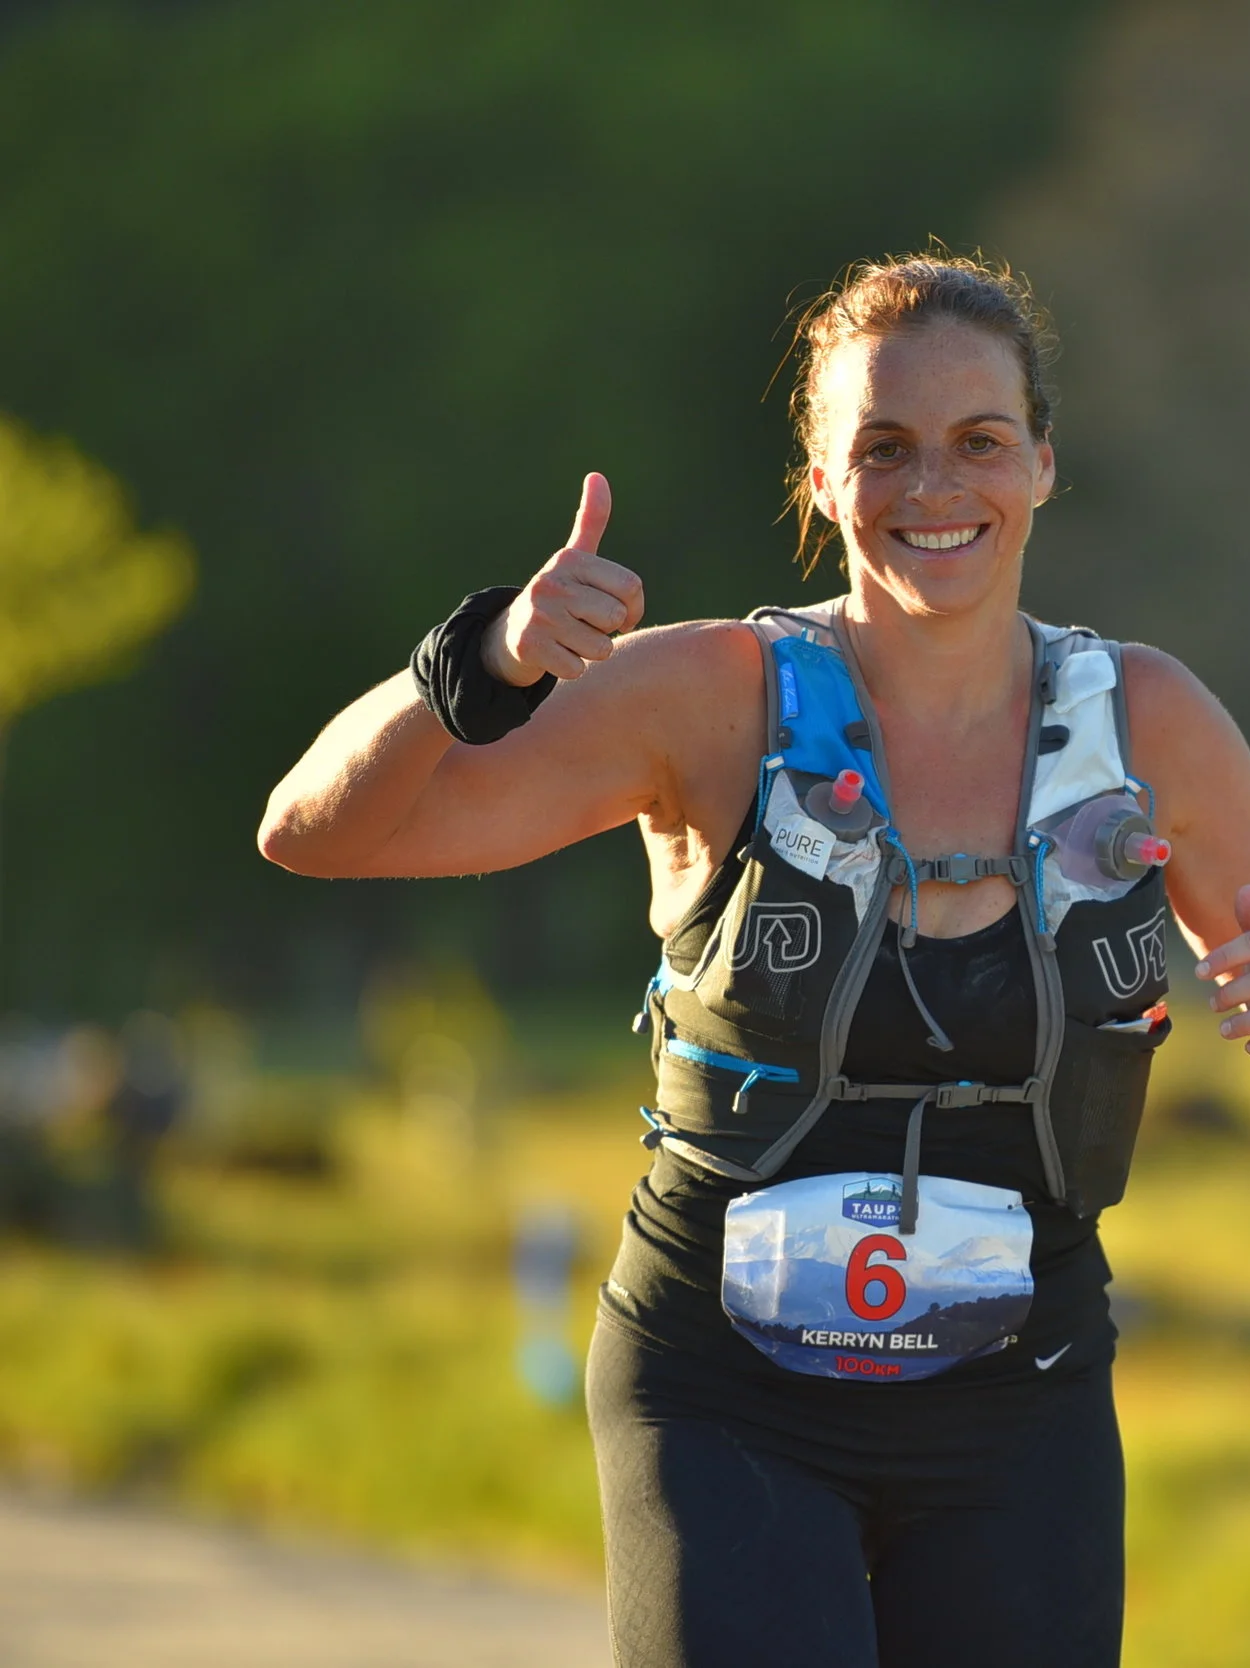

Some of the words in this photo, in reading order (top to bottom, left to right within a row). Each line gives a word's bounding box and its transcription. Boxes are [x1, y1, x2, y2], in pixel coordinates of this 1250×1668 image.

[775, 828, 825, 858] PURE
[852, 1202, 902, 1215] TAUP
[845, 1233, 907, 1321] 6
[801, 1329, 884, 1349] KERRYN
[889, 1333, 938, 1350] BELL
